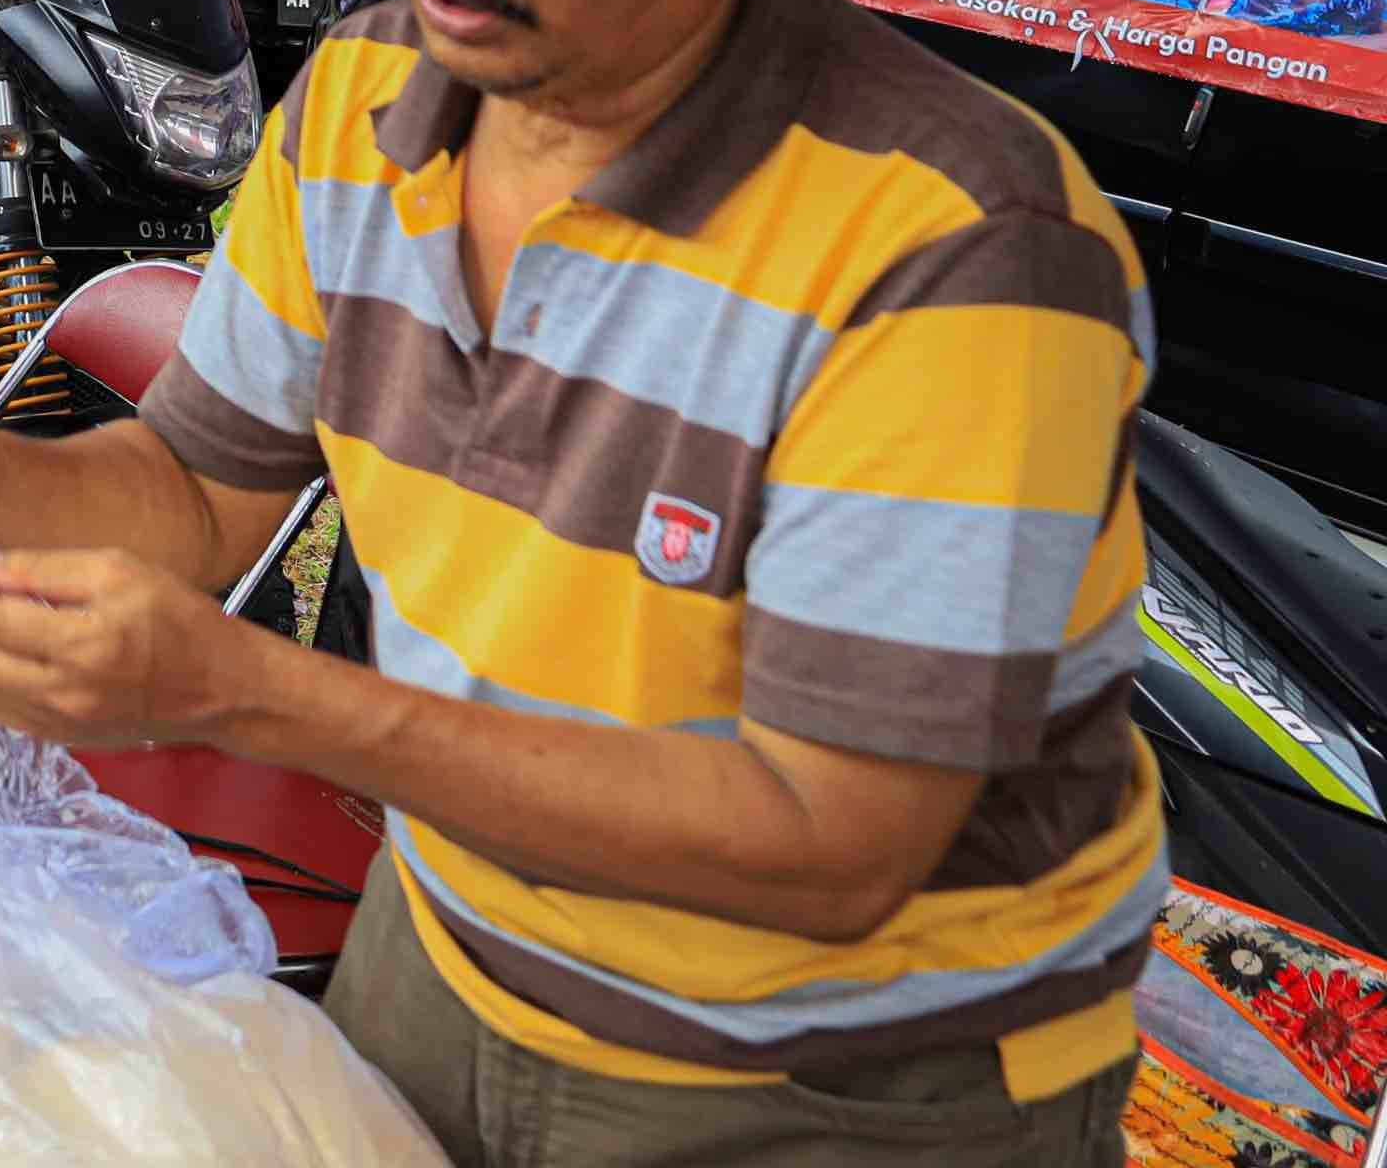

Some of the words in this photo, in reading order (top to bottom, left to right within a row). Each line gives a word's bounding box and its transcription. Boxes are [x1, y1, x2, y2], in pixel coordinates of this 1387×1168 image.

[1067, 9, 1094, 34] &
[1102, 15, 1197, 60] Harga
[1205, 36, 1328, 84] Pangan
[41, 172, 76, 206] AA
